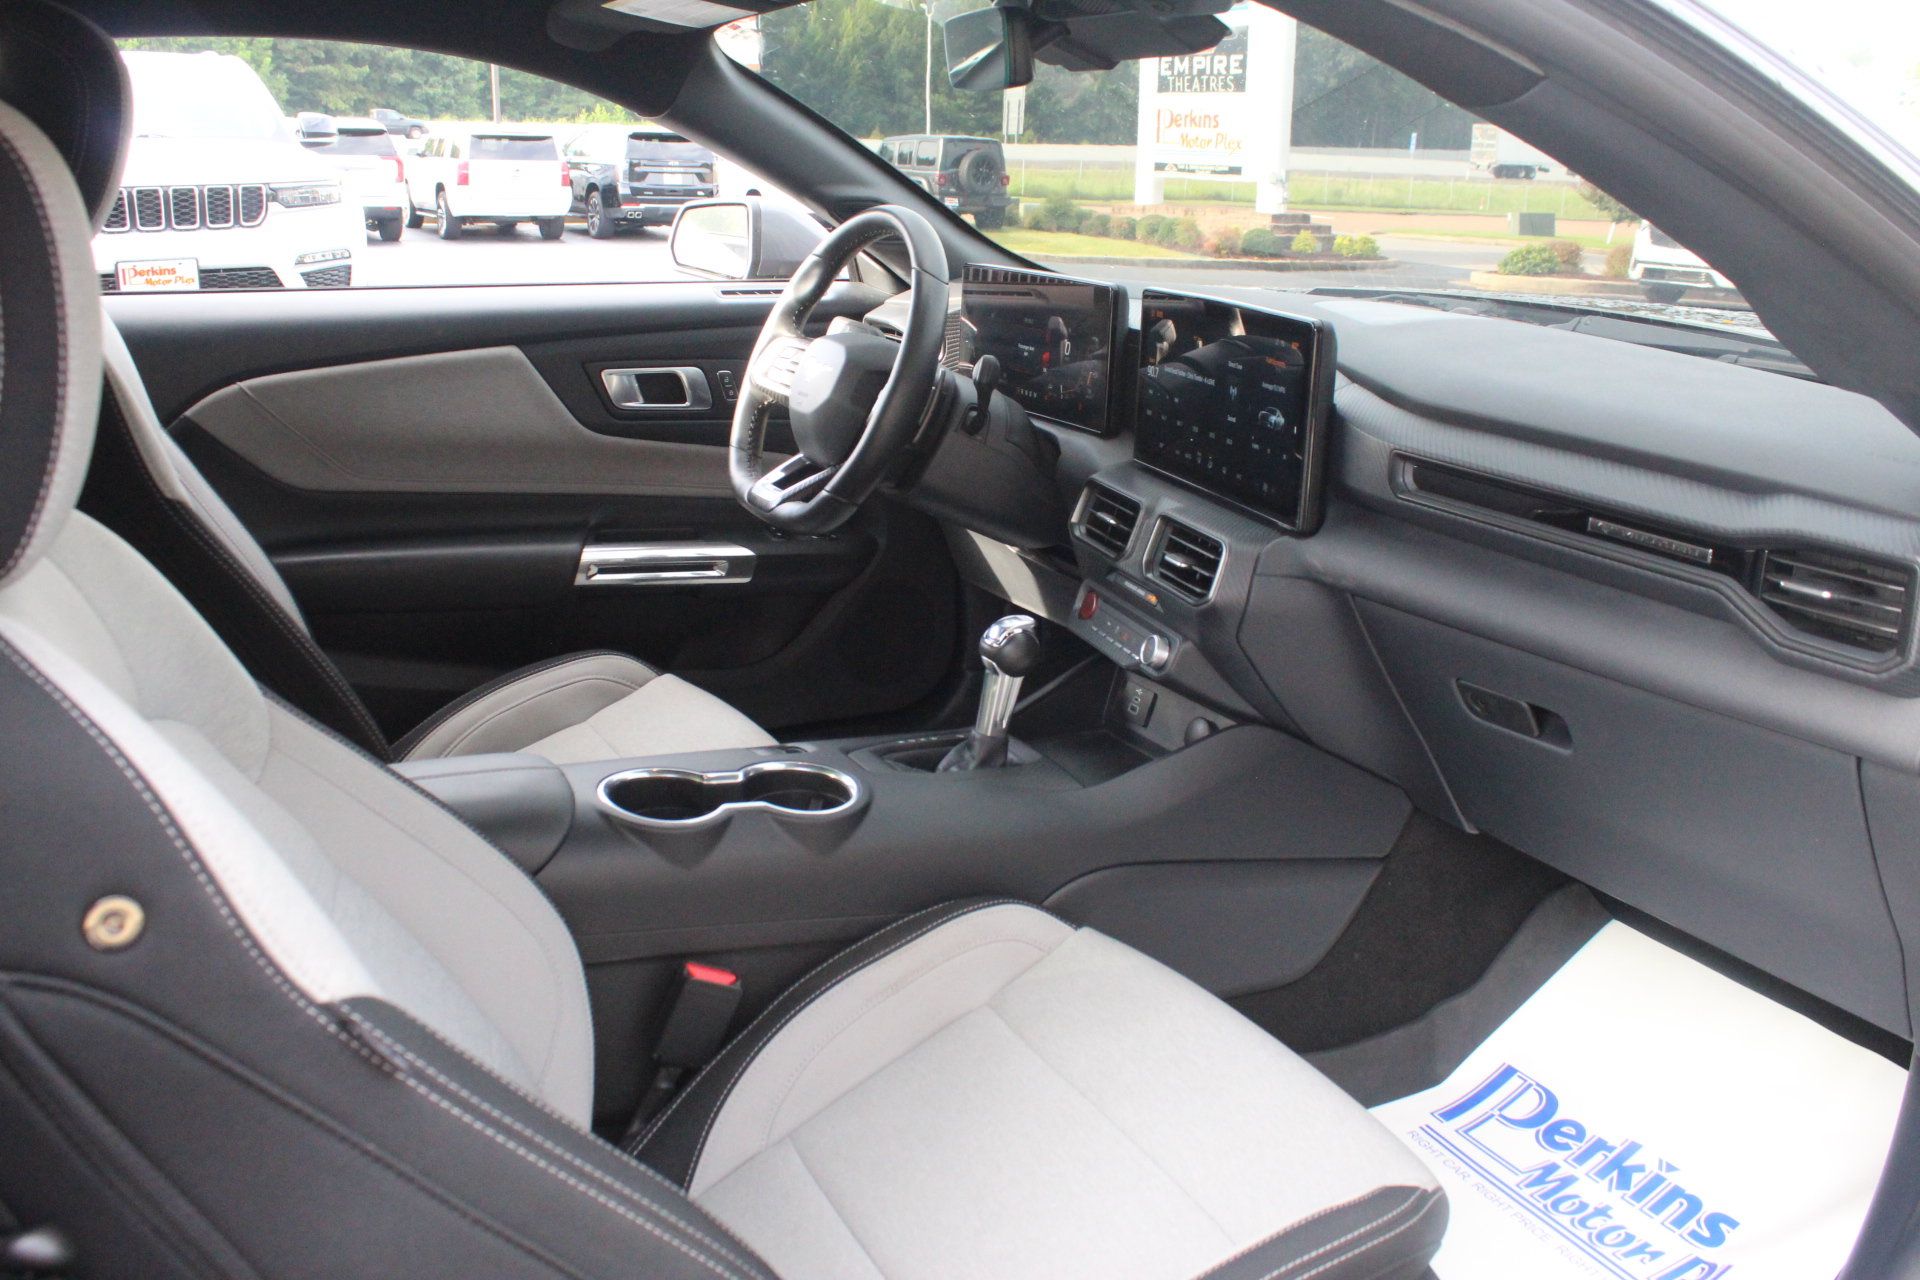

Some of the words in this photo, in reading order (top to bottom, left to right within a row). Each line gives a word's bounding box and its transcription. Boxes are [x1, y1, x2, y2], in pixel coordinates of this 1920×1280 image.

[1160, 54, 1244, 76] EMPIRE
[1168, 76, 1235, 92] THEATRES
[1156, 109, 1220, 142] Perkins
[1180, 133, 1211, 150] Motor
[121, 266, 177, 285] Perkins
[1407, 1129, 1446, 1158] RIGHT
[1430, 1062, 1741, 1248] Perkins
[1516, 1160, 1666, 1264] Motor
